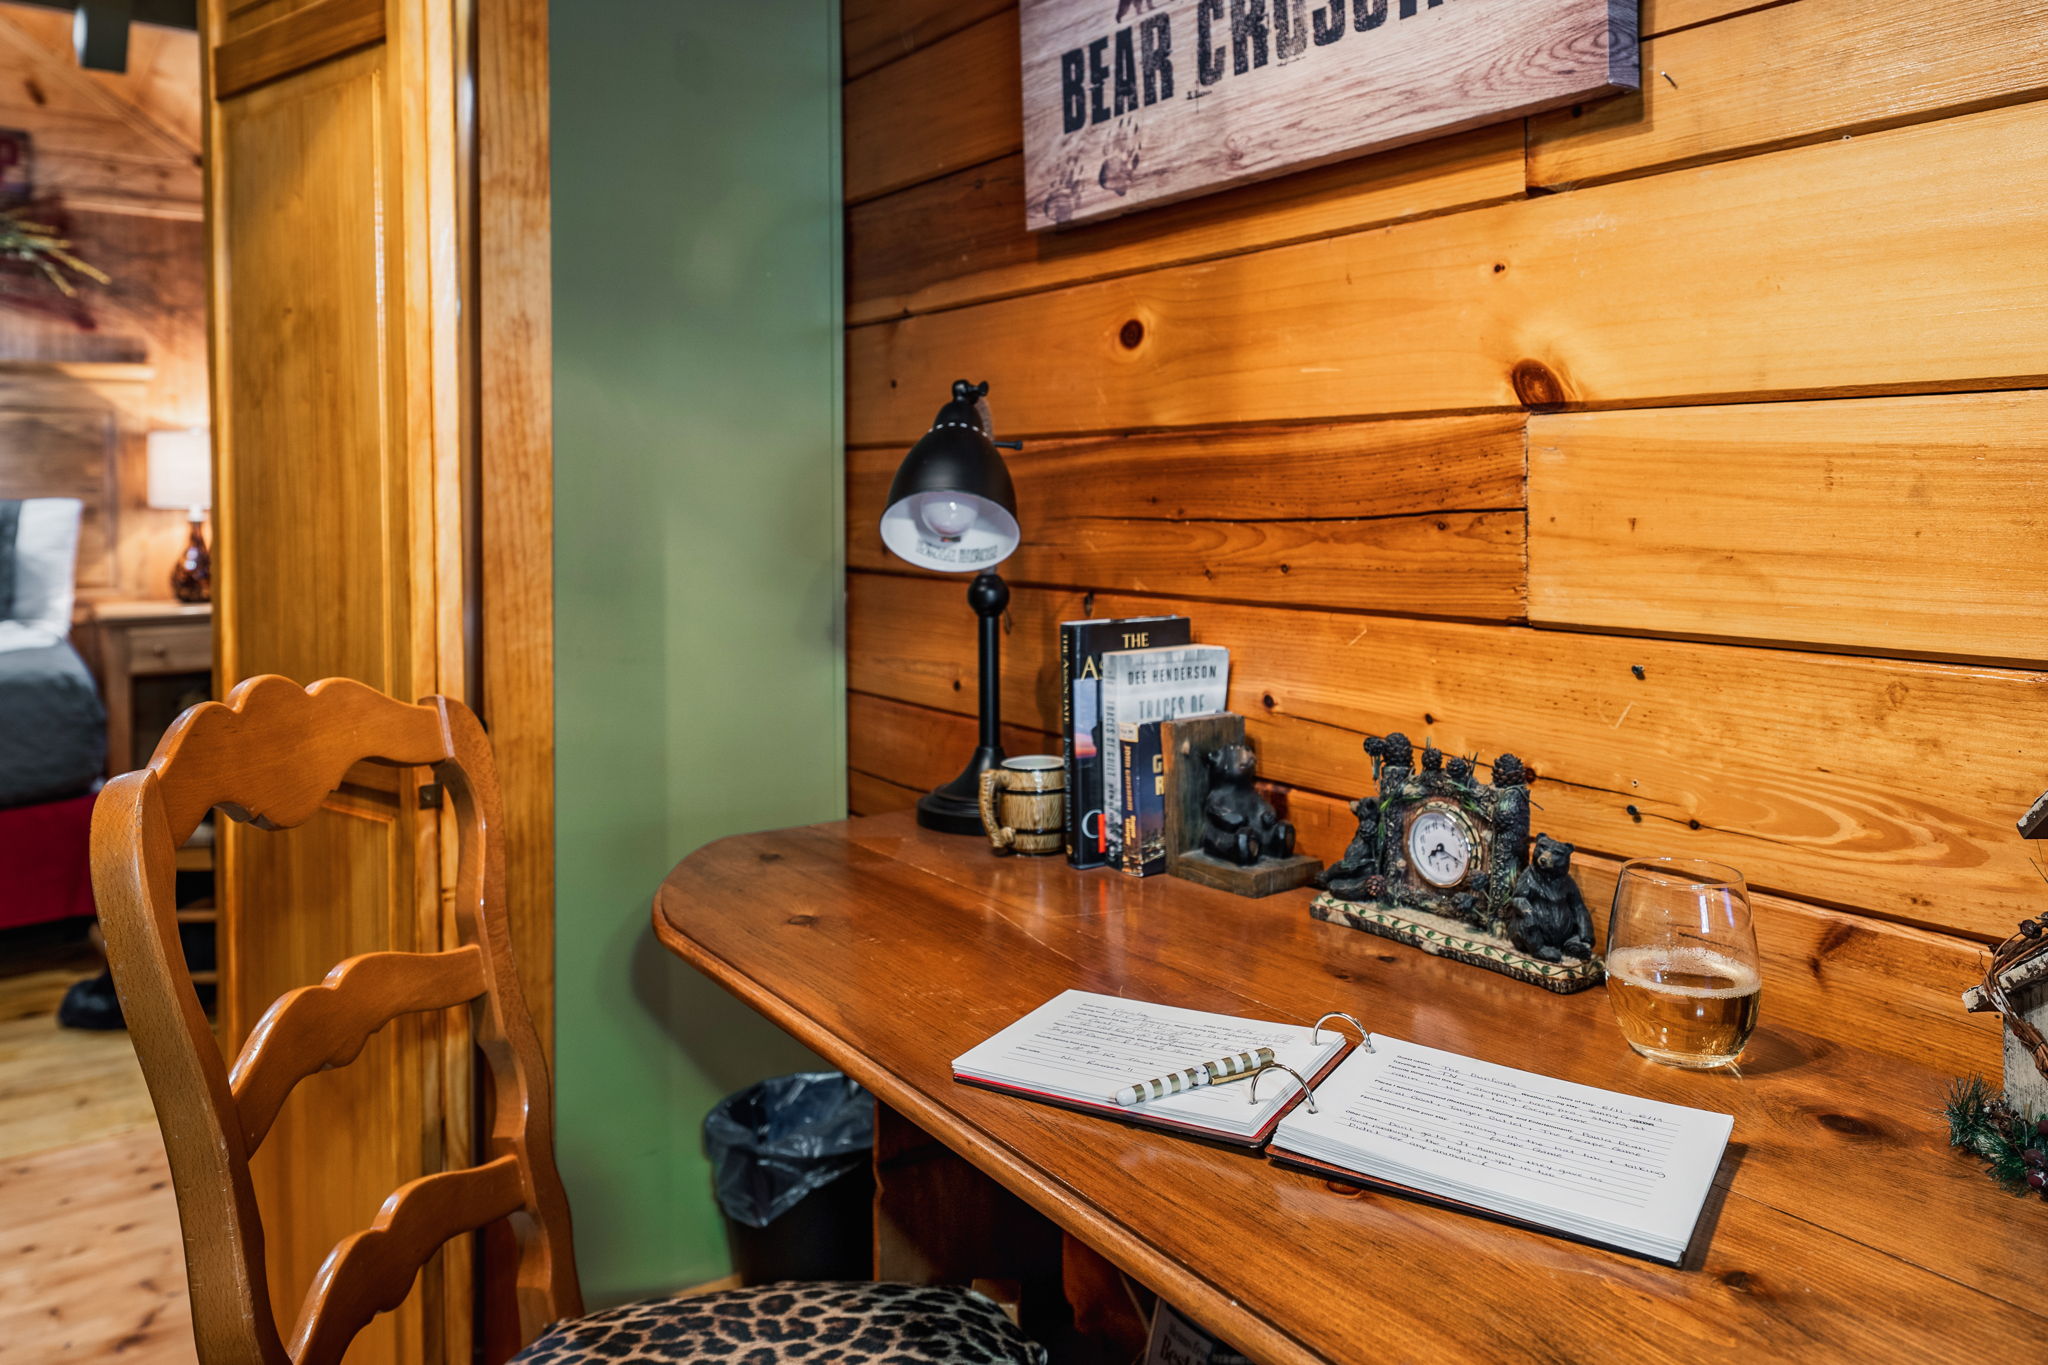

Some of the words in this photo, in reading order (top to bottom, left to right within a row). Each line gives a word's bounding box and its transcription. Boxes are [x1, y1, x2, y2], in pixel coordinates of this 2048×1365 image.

[1061, 12, 1174, 135] BEAR
[1122, 631, 1150, 649] THE
[1127, 670, 1147, 686] DEE
[1152, 665, 1217, 683] HENDERSON
[1139, 696, 1185, 720] TRACES
[1191, 694, 1205, 713] OF
